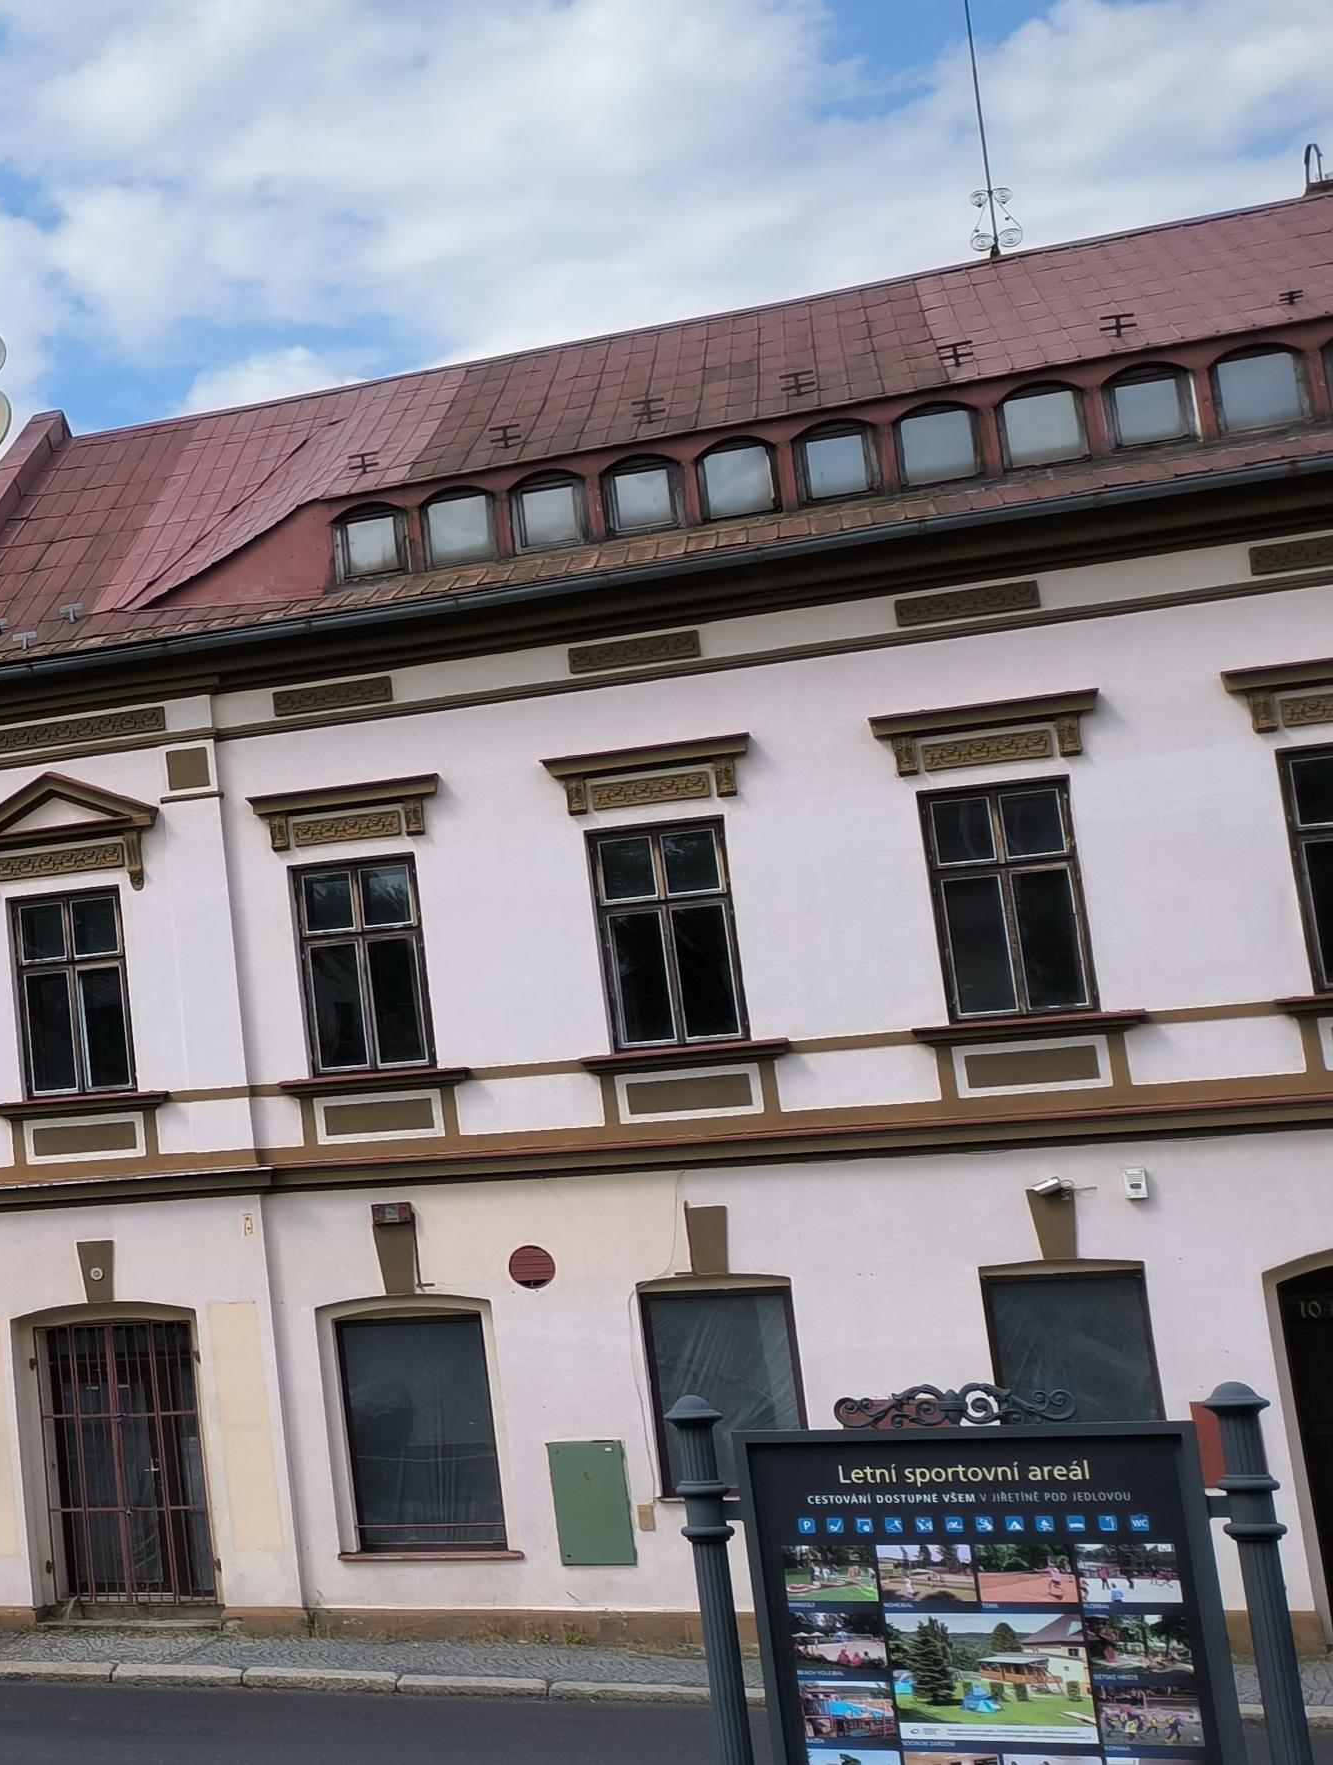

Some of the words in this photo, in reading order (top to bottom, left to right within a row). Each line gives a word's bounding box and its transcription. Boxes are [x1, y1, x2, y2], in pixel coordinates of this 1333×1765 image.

[837, 1463, 897, 1484] Letní
[904, 1461, 1020, 1488] sportovní
[1028, 1459, 1091, 1482] areál
[807, 1493, 872, 1505] CESTOVÁNÍ
[876, 1491, 939, 1504] DOSTUPNÉ
[941, 1491, 976, 1504] VŠEM
[979, 1493, 987, 1503] V
[1044, 1492, 1068, 1503] POD
[1072, 1490, 1132, 1502] JEDLOVOU
